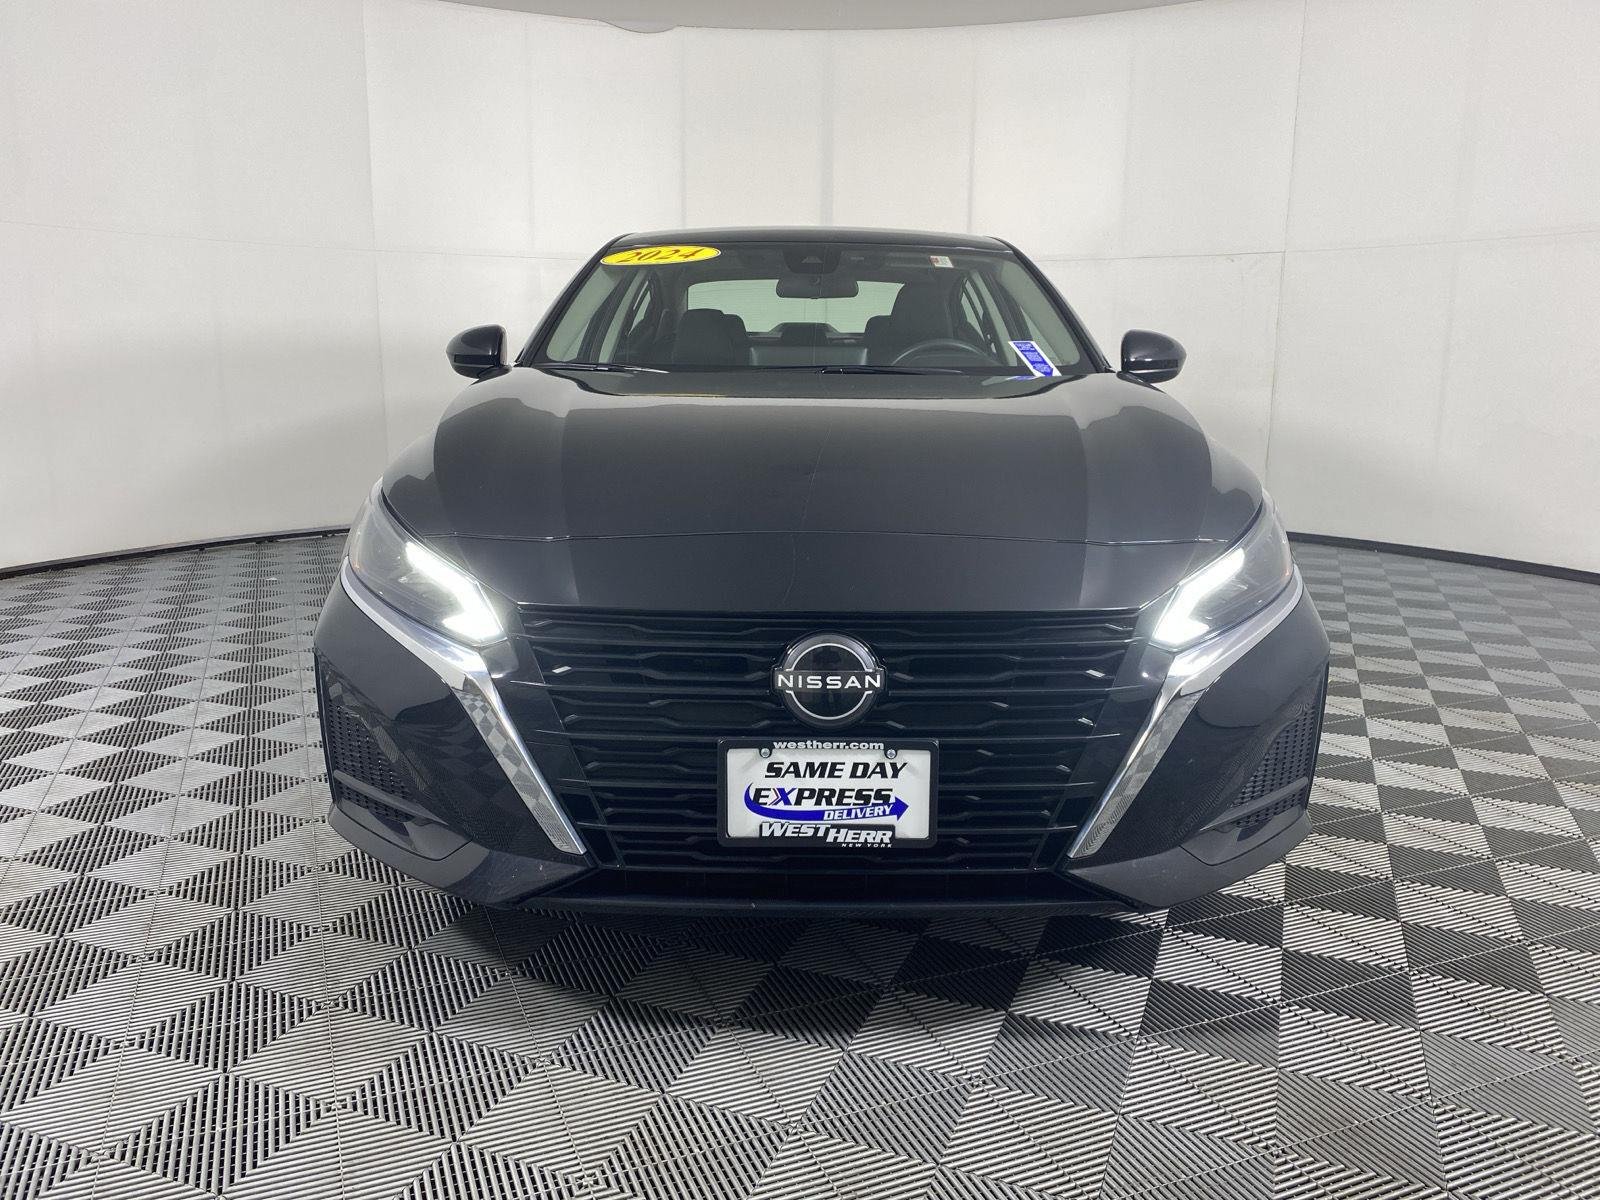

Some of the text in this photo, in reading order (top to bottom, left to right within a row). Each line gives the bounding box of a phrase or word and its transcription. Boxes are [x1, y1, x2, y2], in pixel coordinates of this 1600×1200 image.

[617, 248, 705, 263] 2024
[777, 674, 881, 689] NISSAN
[772, 740, 885, 750] westherr.com
[765, 761, 908, 779] SAME DAY
[752, 788, 893, 806] EXPRESS
[823, 804, 894, 821] DELIVERY
